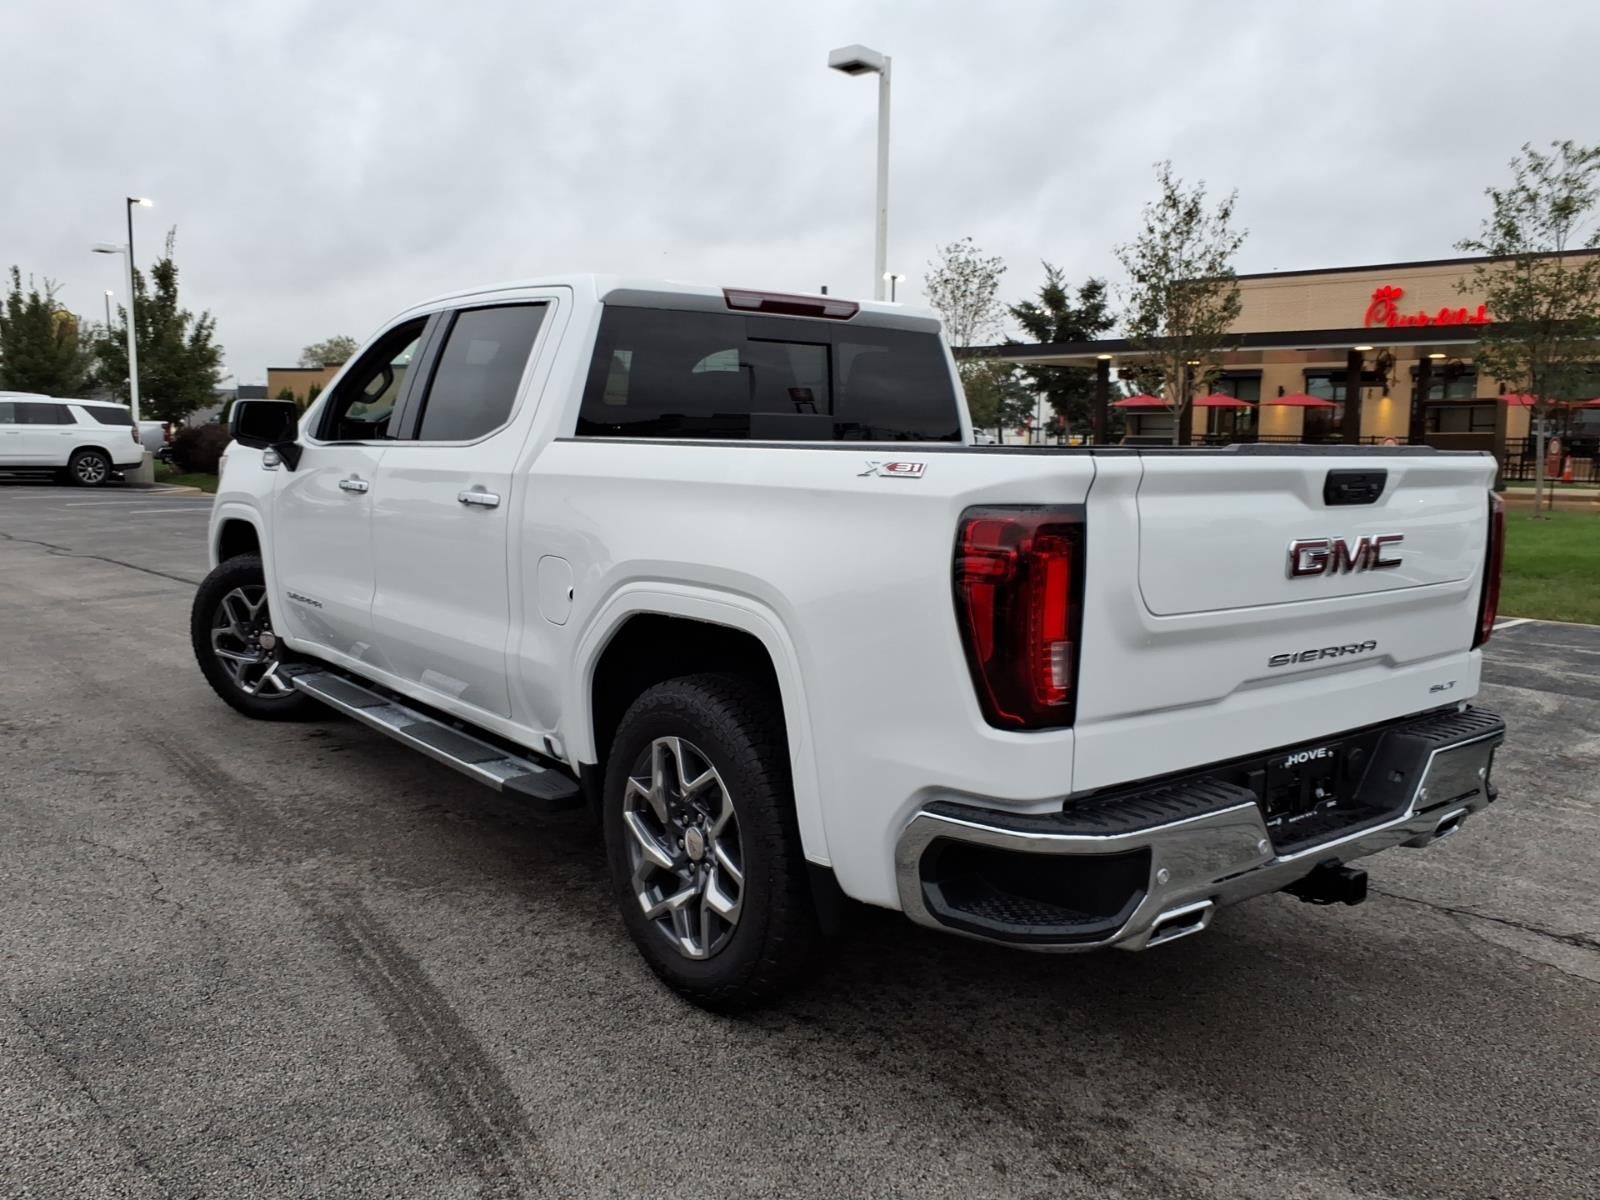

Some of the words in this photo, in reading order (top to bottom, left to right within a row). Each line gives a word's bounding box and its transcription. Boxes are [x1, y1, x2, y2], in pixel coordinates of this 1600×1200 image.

[857, 460, 928, 479] X31
[1286, 534, 1404, 579] GMC
[1268, 640, 1377, 668] SIERRA
[1429, 680, 1456, 694] SLT
[1287, 747, 1327, 765] HOVE
